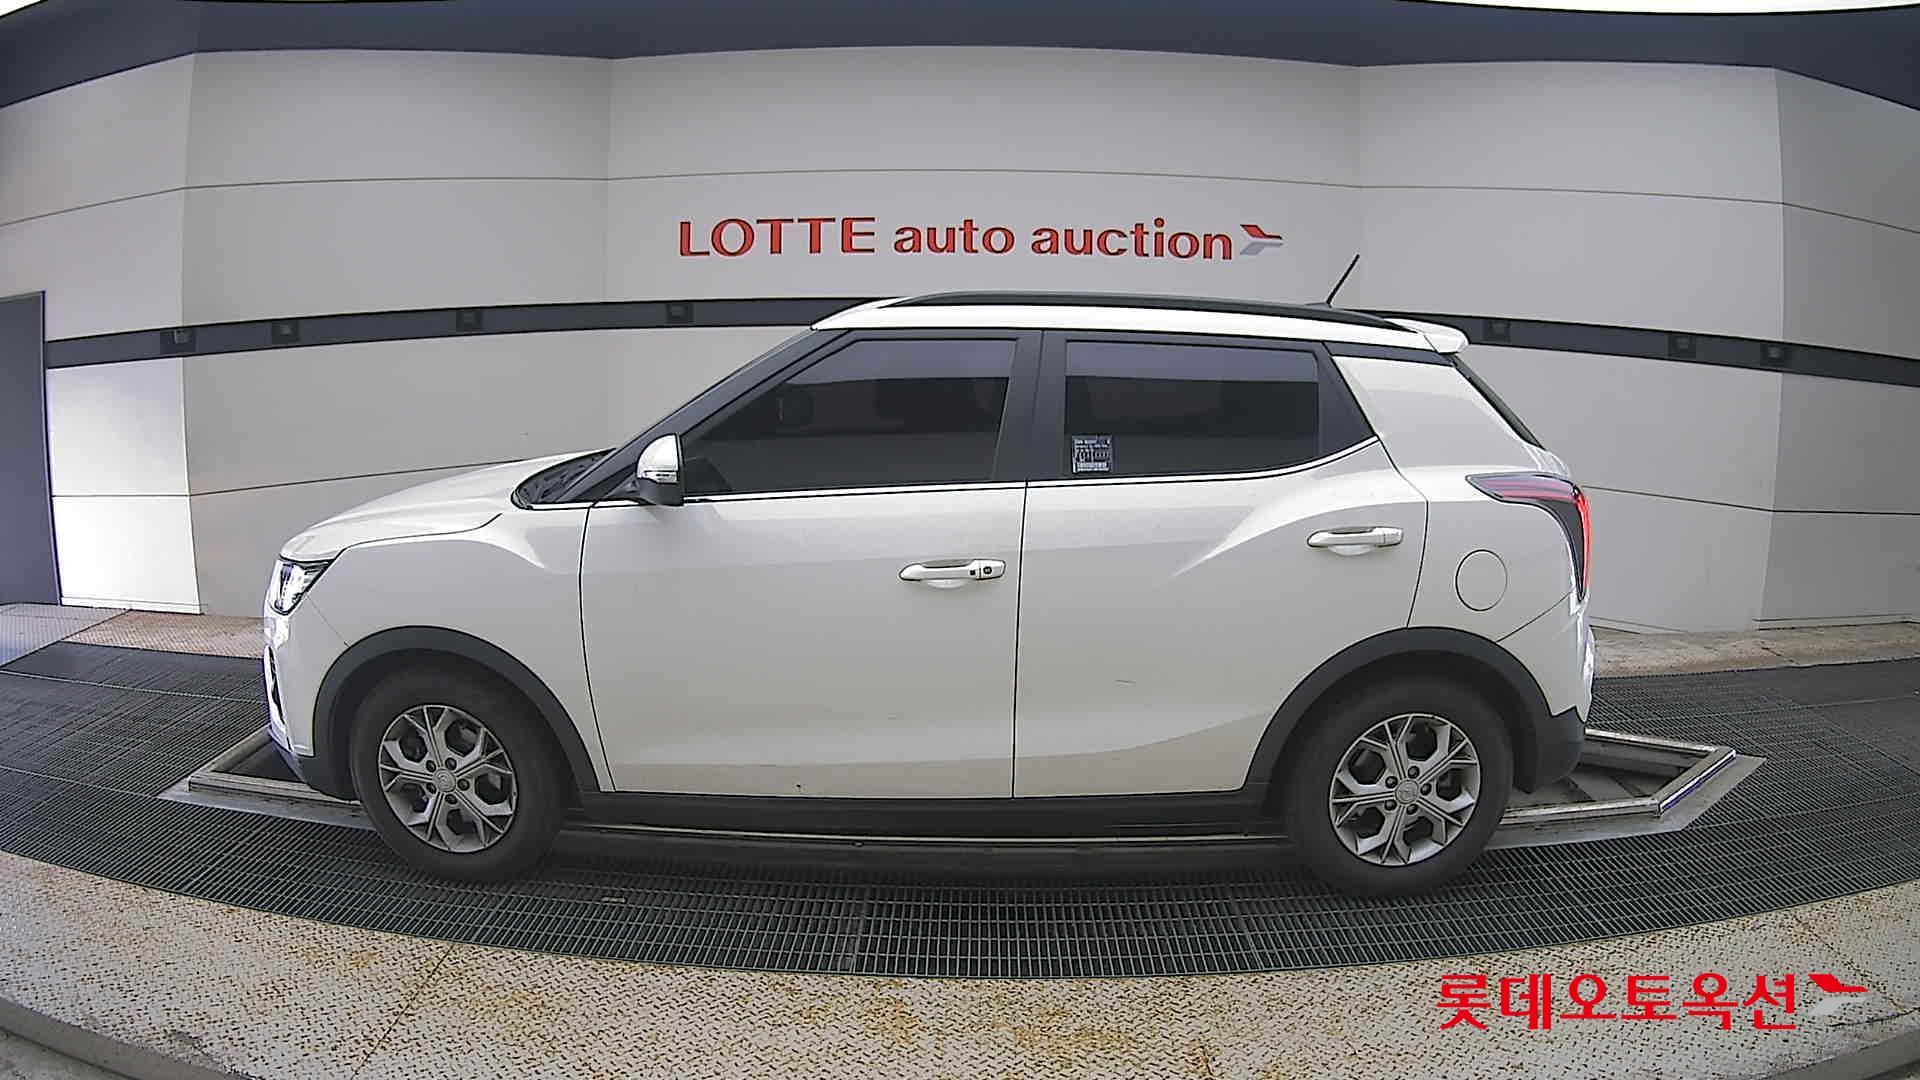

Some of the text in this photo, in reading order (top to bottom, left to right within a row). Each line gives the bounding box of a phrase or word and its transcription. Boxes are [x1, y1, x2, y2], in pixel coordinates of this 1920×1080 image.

[679, 216, 1234, 261] LOTTE auto auction
